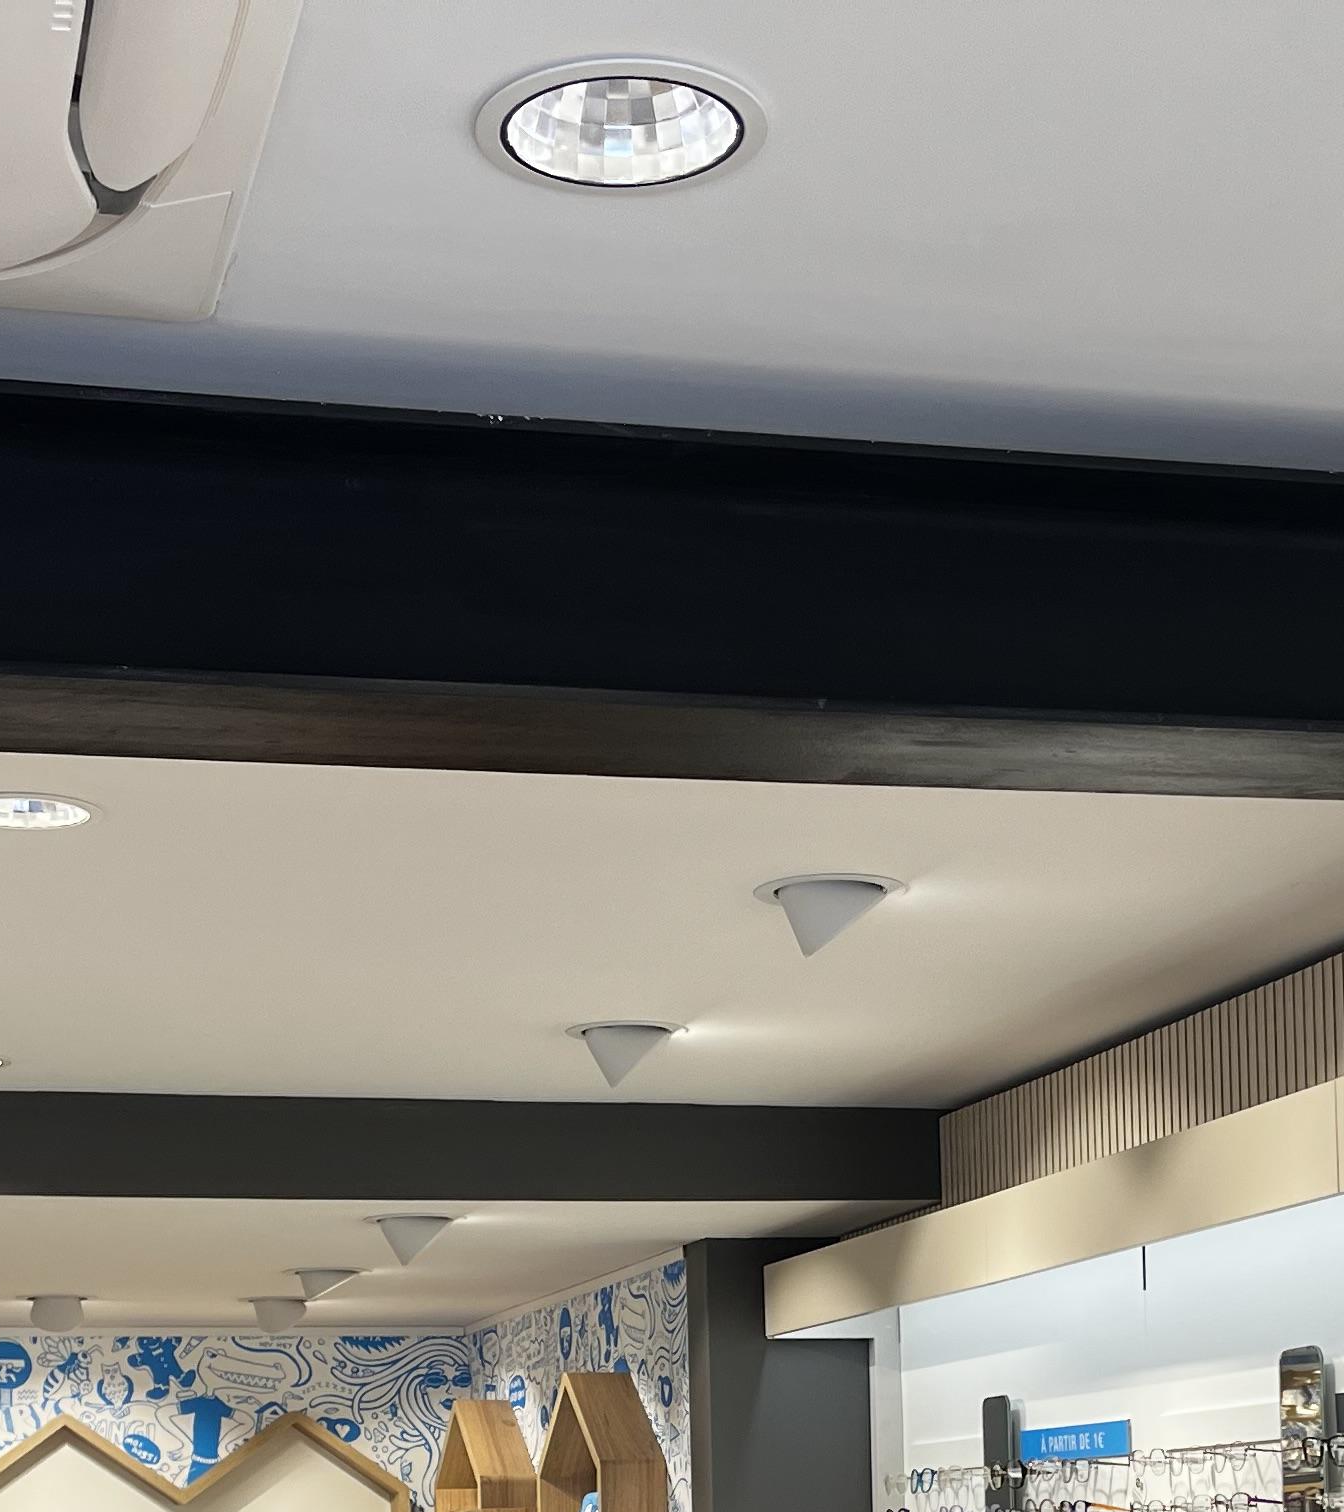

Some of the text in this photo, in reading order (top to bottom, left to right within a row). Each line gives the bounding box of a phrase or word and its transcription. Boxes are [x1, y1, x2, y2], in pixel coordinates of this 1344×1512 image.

[1040, 1434, 1048, 1453] À
[1048, 1434, 1077, 1452] PARTIR
[1079, 1432, 1091, 1450] DE
